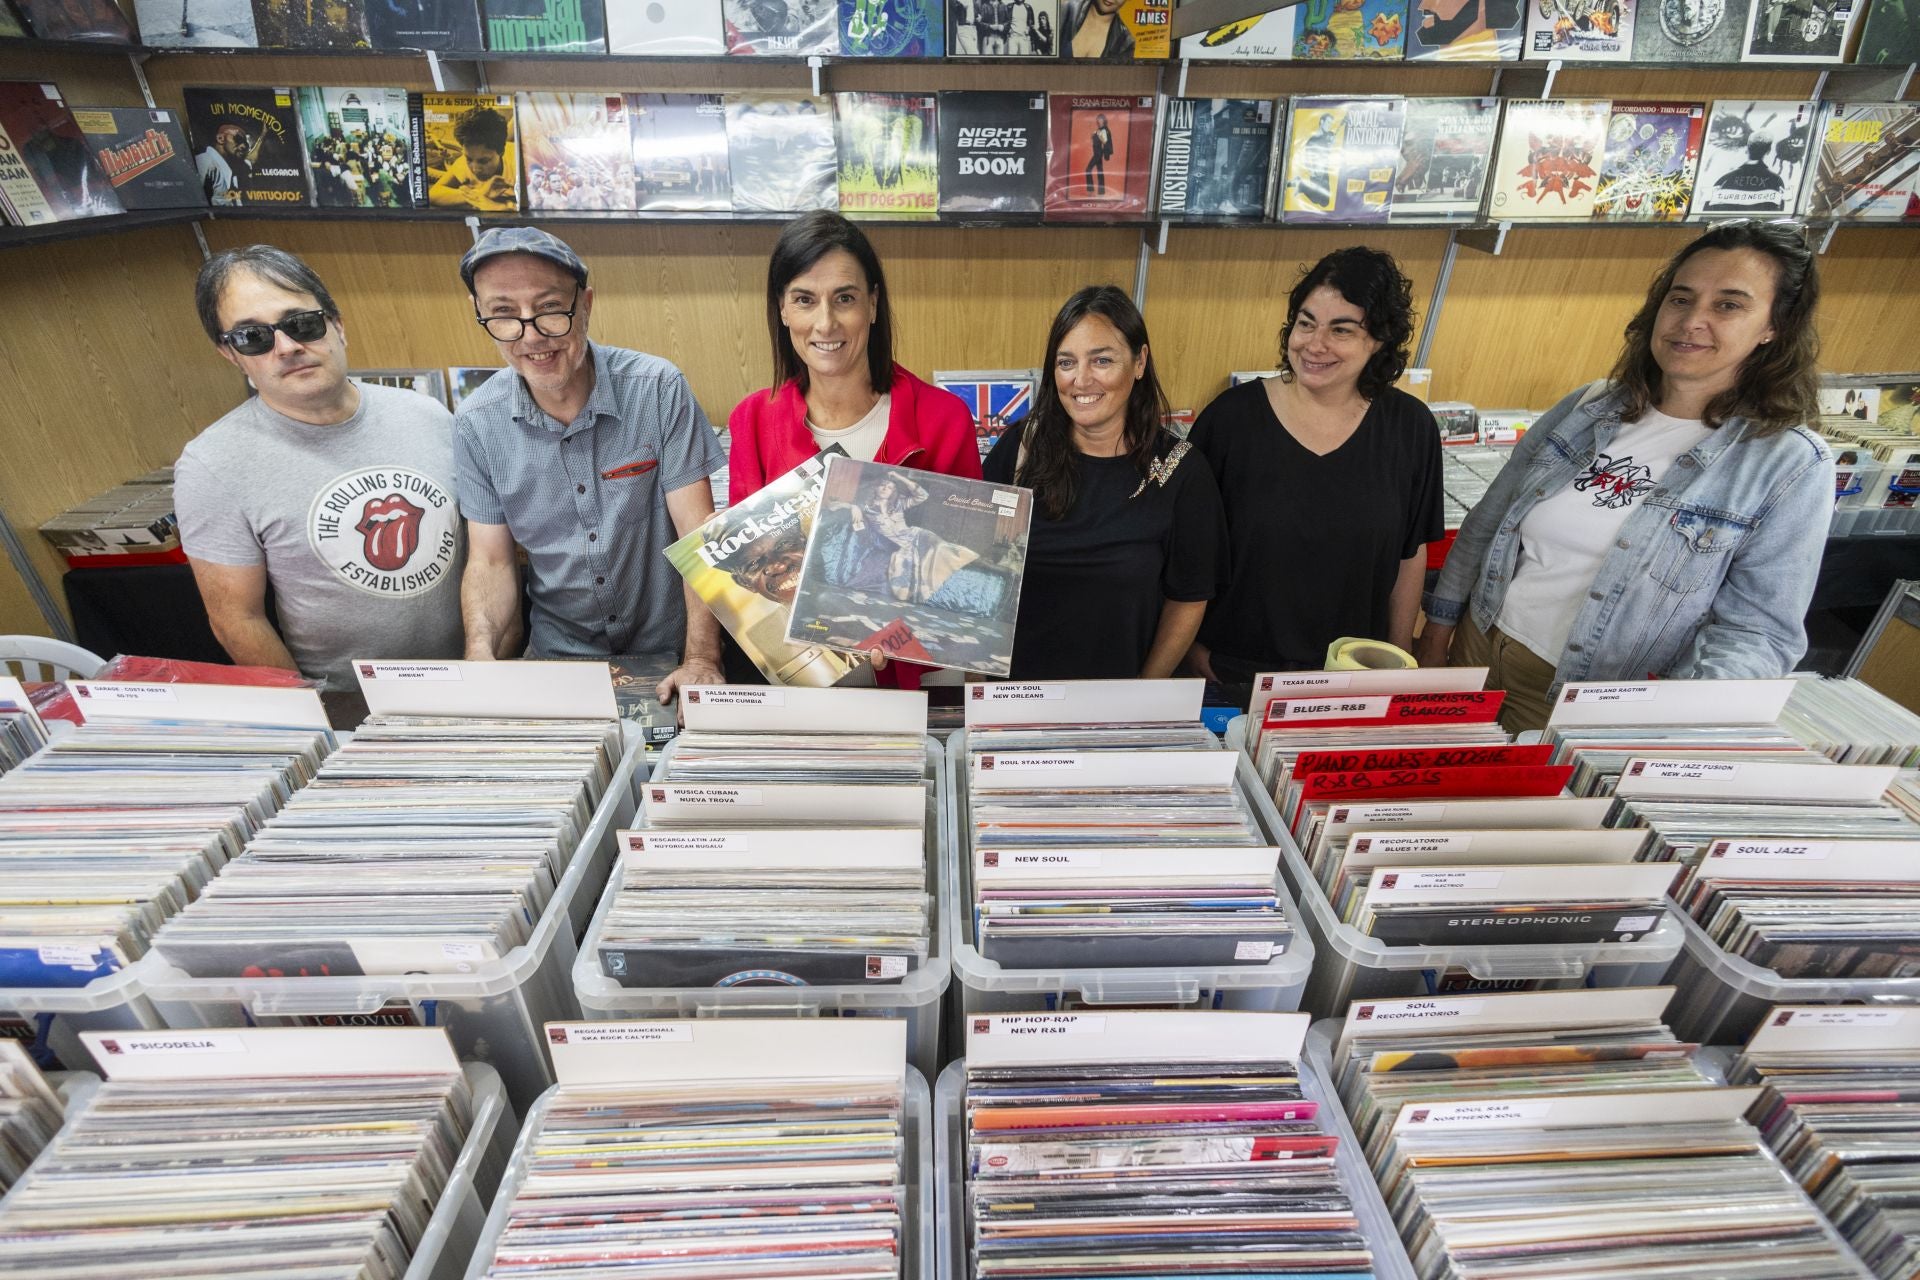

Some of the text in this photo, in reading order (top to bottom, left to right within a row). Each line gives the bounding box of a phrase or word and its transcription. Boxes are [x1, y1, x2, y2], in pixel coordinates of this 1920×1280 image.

[1136, 12, 1167, 24] JAMES
[488, 19, 587, 52] morrison
[210, 103, 225, 115] UN
[1072, 98, 1131, 108] SUSANA ESTRADA
[1509, 100, 1565, 109] MONSTER
[1170, 100, 1195, 129] VAN
[1348, 110, 1380, 128] SOCIAL
[958, 128, 1027, 138] NIGHT
[1345, 127, 1400, 146] DISTORTION
[411, 117, 420, 164] Sebastian
[957, 138, 1028, 148] BEATS
[958, 157, 1026, 175] BOOM
[1162, 130, 1192, 211] MORRISON
[414, 176, 422, 200] Belle
[895, 191, 936, 209] STYLE
[318, 473, 448, 541] THE ROLLING STONES
[693, 475, 823, 568] Rockstead
[340, 531, 454, 592] ESTABLISHED 1962
[1293, 704, 1332, 714] BLUES
[1400, 706, 1468, 717] BLANCOS
[1312, 773, 1373, 789] R&B
[1736, 846, 1808, 855] SOUL JAZZ
[1448, 916, 1592, 926] STEREOPHONIC
[1406, 1002, 1437, 1010] SOUL
[1001, 1016, 1022, 1024] HIP
[1376, 1010, 1460, 1020] RECOPILATORIOS
[130, 1041, 216, 1050] PSICODELIA
